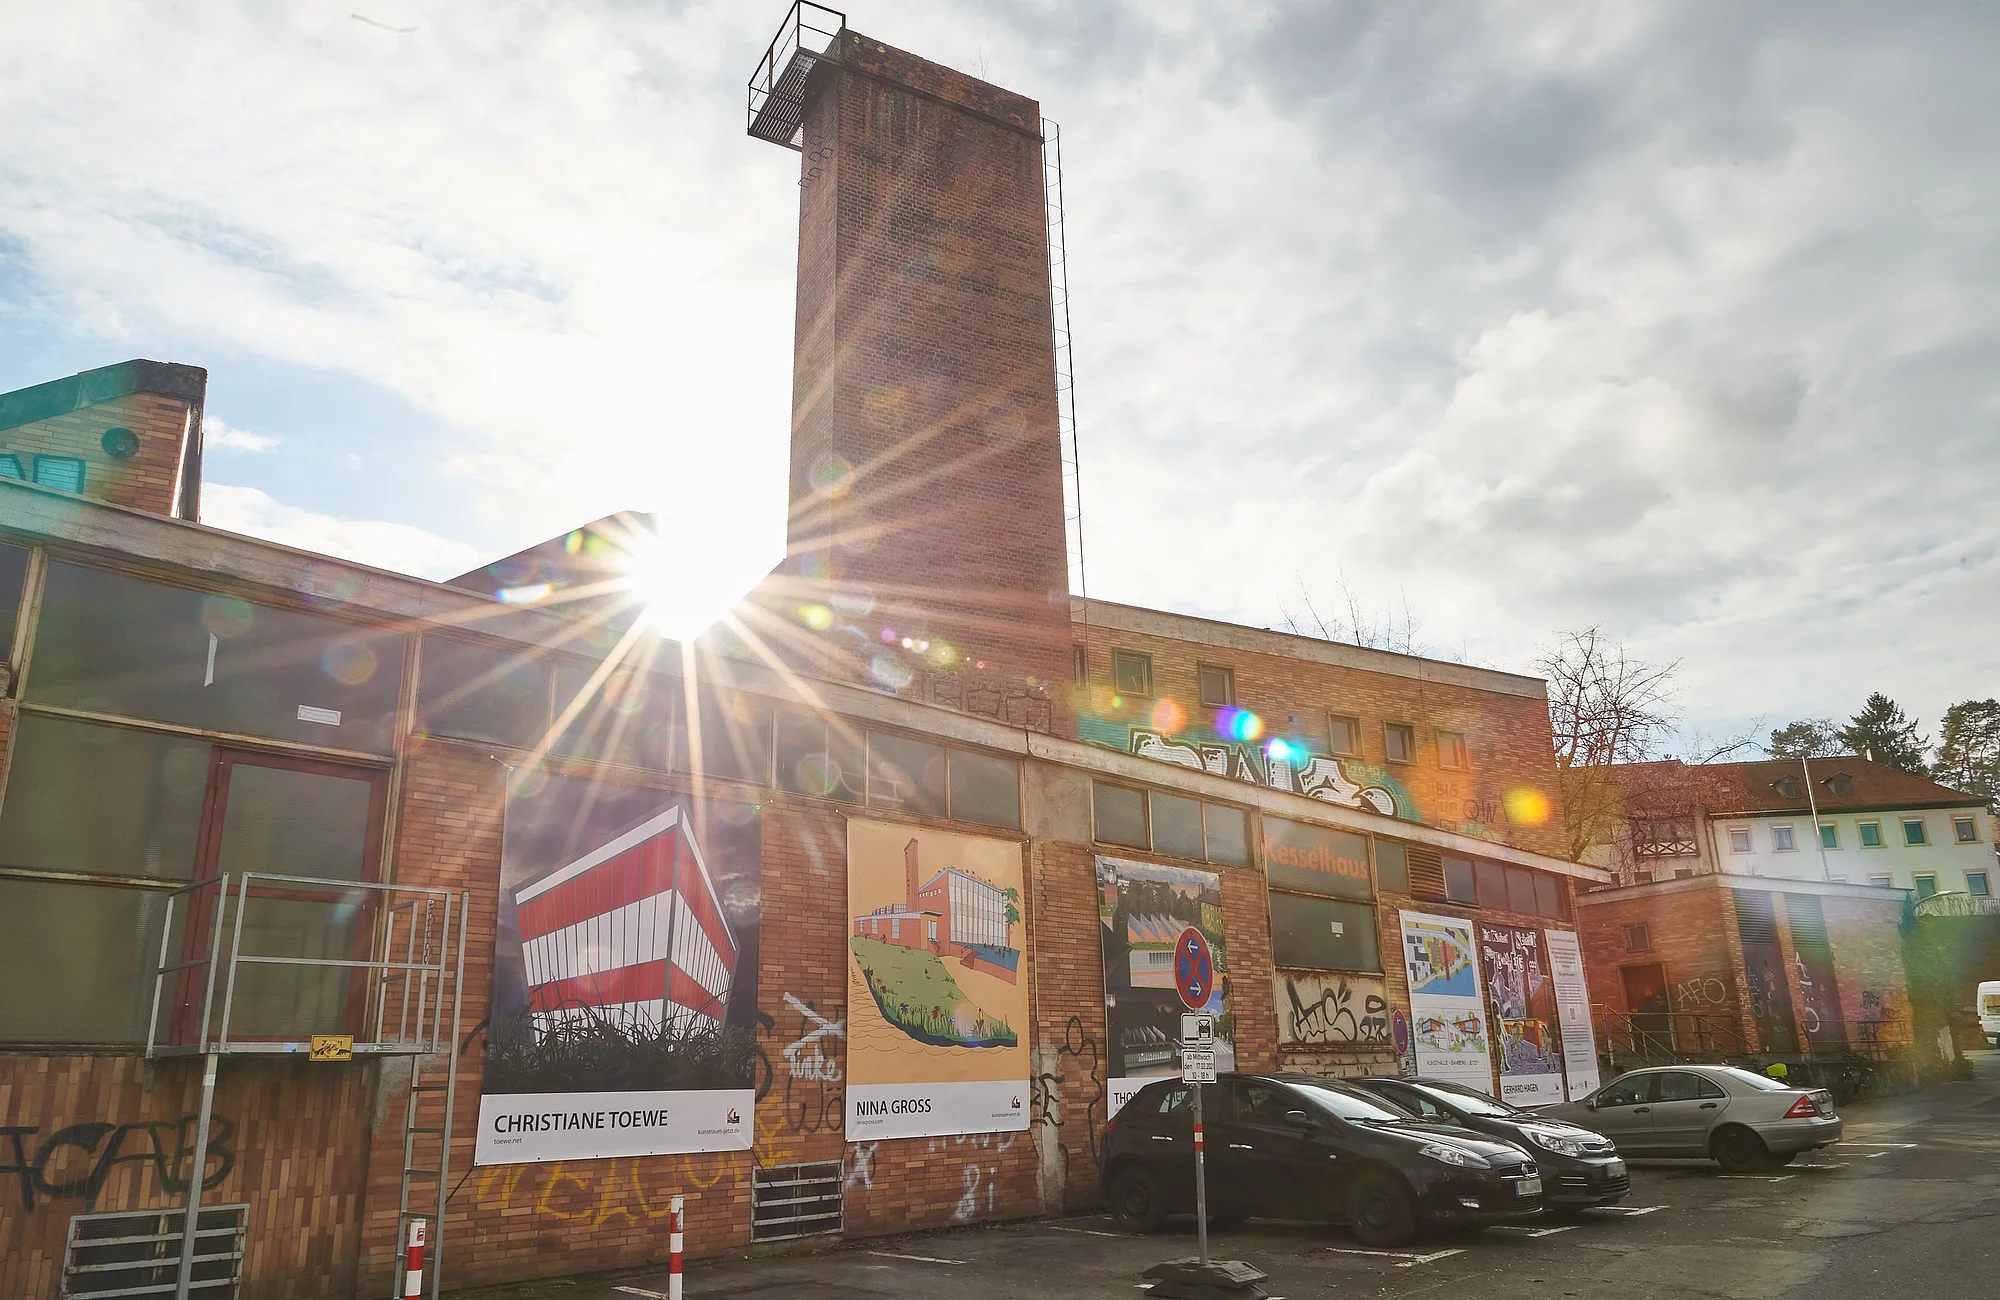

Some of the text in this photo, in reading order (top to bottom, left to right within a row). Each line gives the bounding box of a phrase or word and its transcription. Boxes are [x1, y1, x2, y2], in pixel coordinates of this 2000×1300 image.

[1264, 833, 1369, 879] Kesselhaus
[1503, 1083, 1539, 1094] GERHARD HAGEN
[857, 1098, 932, 1116] NINA GROSS
[1113, 1091, 1137, 1105] THO
[494, 1110, 668, 1133] CHRISTIANE TOEWE
